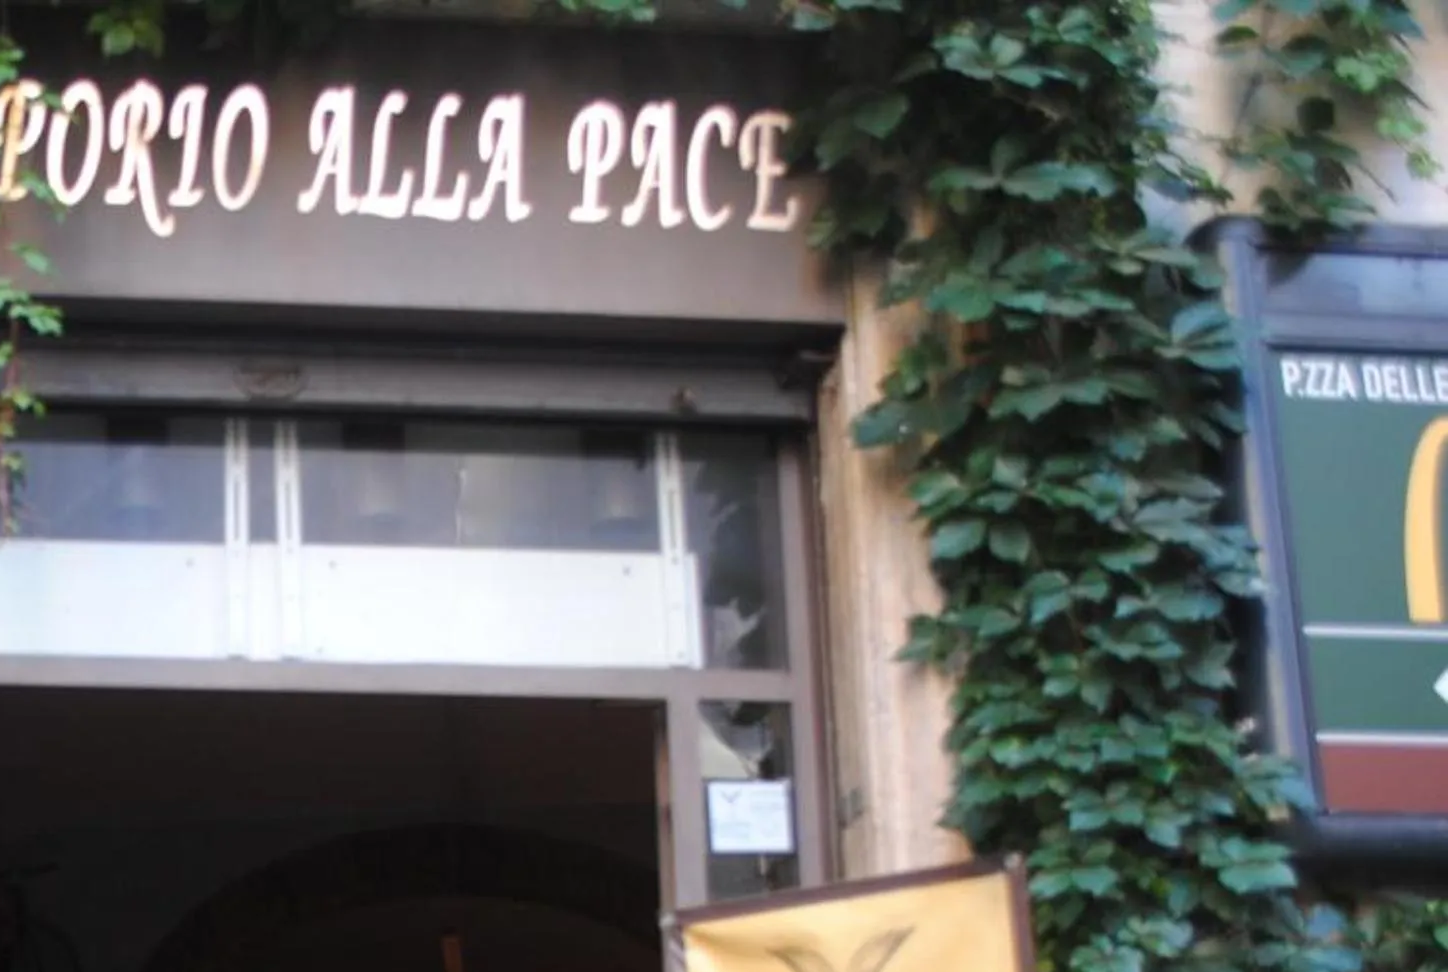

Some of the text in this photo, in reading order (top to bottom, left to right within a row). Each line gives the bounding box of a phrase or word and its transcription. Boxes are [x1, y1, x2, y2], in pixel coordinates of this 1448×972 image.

[297, 86, 532, 223] ALLA
[567, 100, 802, 232] PACE
[1281, 358, 1448, 404] P.ZZA DELLE
